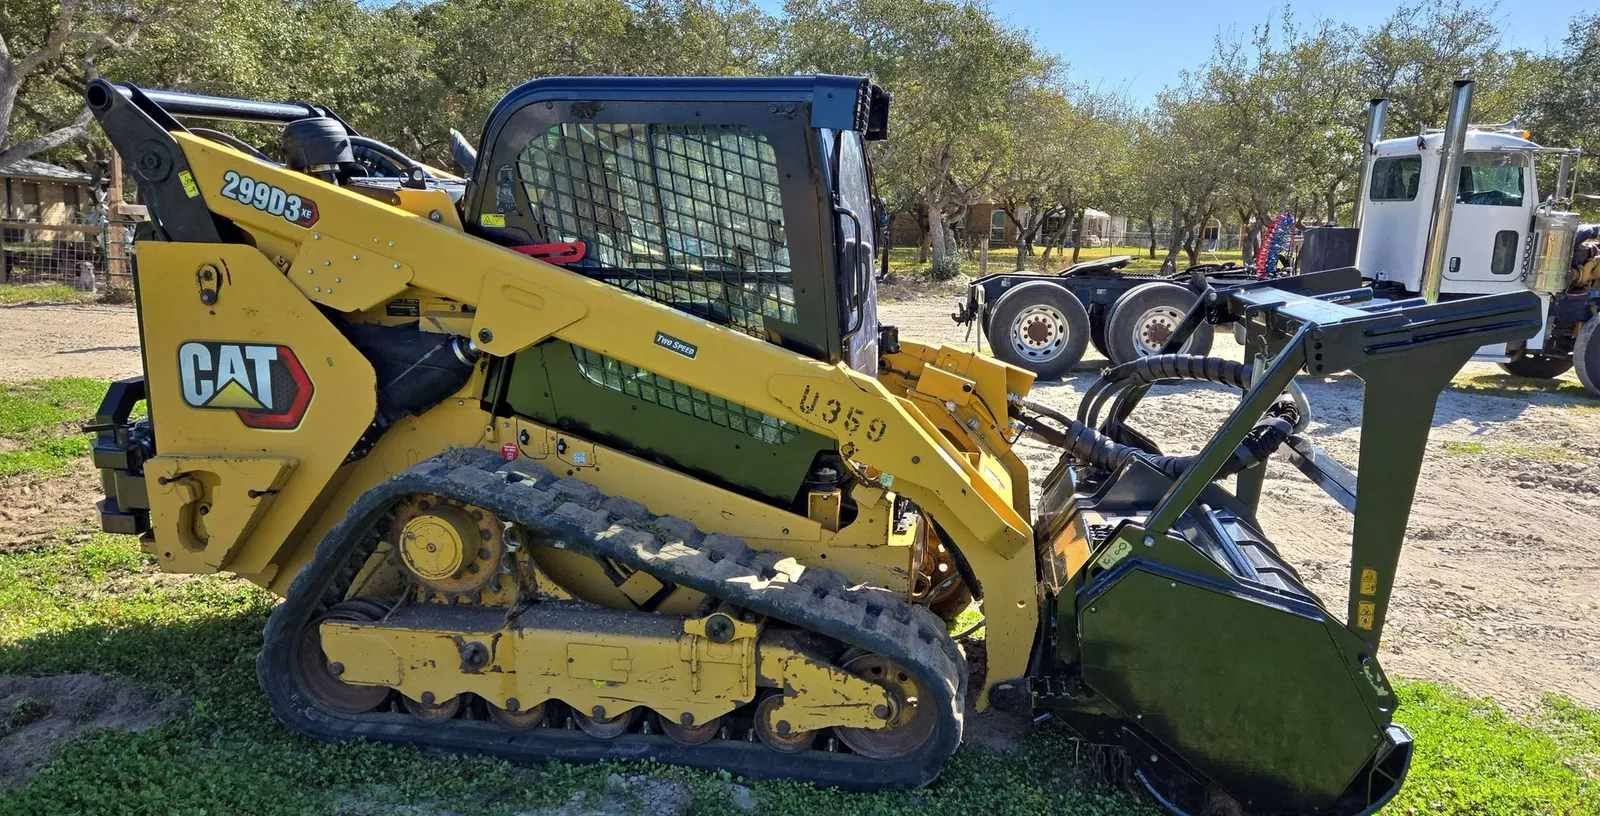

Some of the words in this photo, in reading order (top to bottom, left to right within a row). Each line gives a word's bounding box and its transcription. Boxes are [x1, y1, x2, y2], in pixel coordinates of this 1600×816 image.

[221, 170, 302, 222] 299D3
[301, 208, 312, 219] XE
[179, 342, 278, 410] CAT
